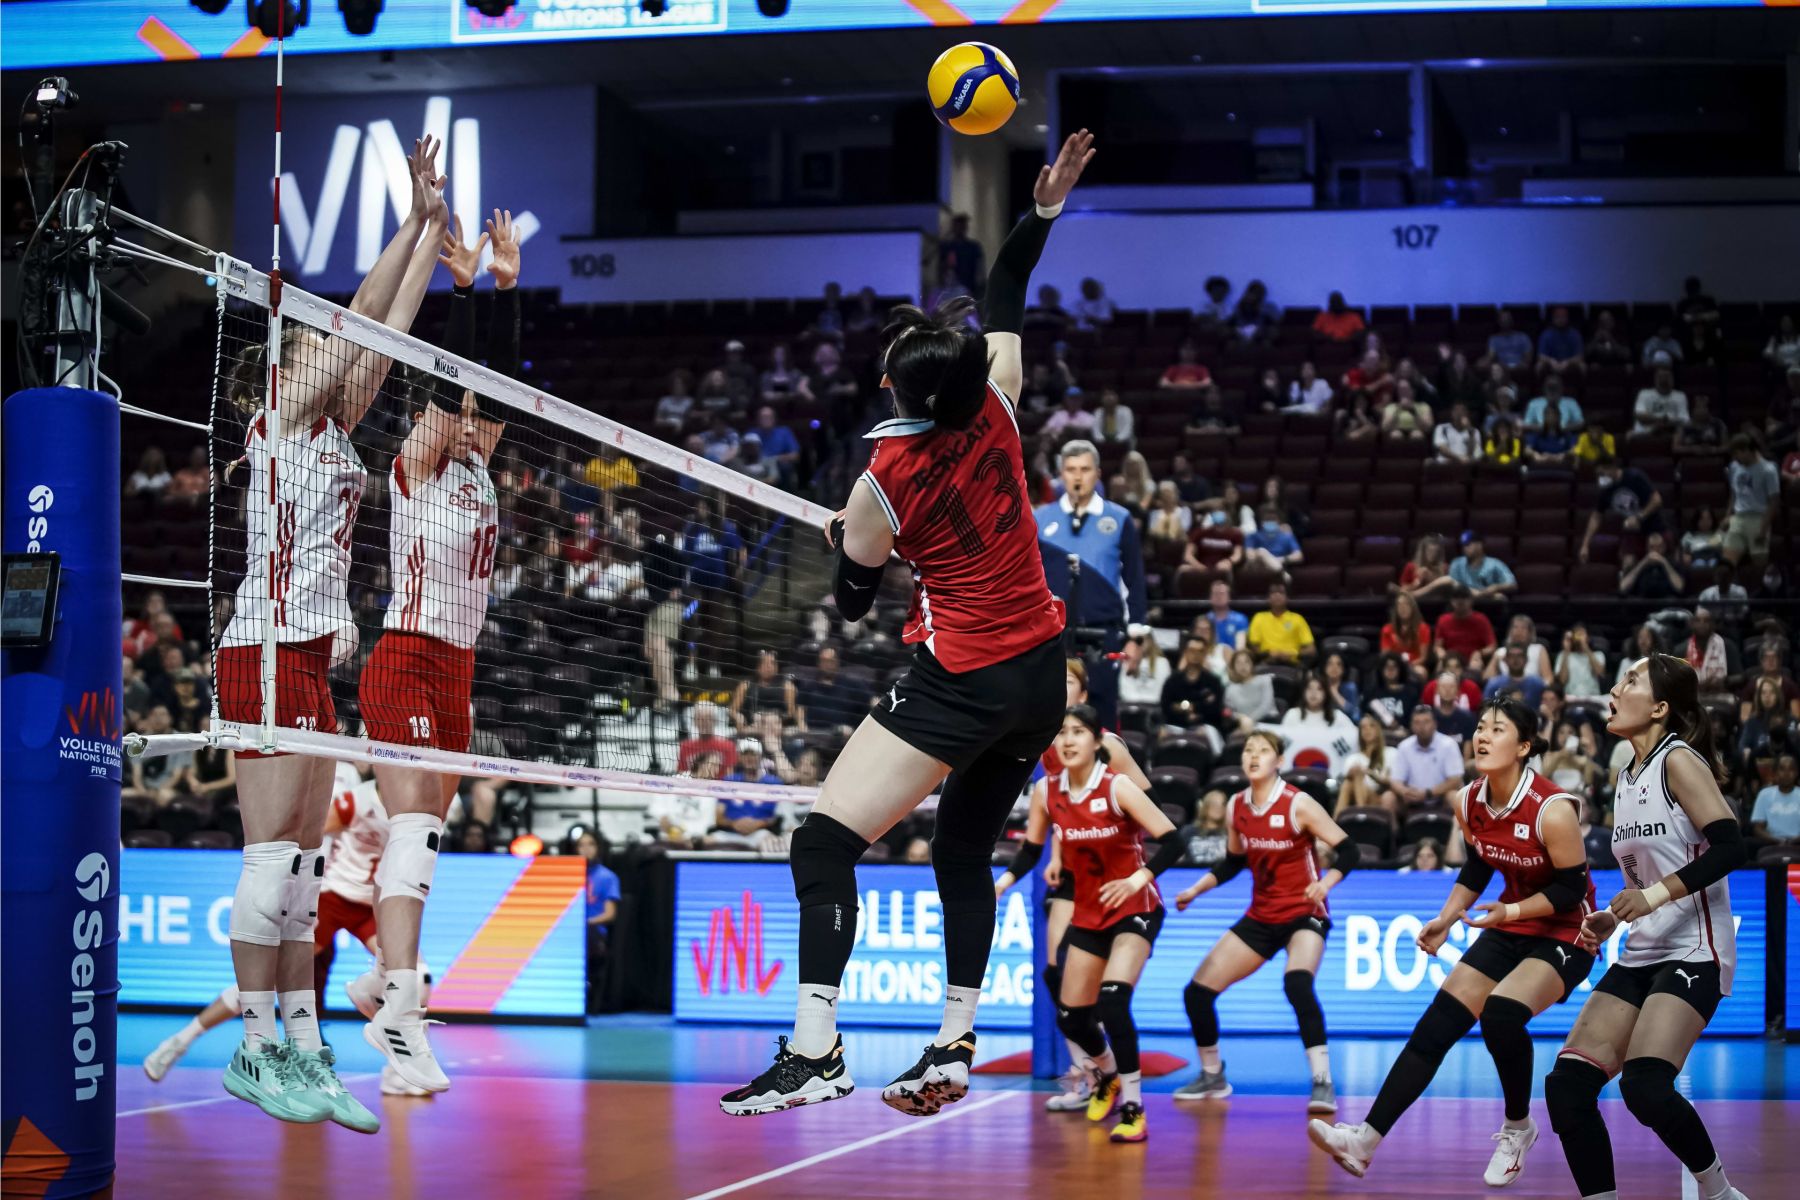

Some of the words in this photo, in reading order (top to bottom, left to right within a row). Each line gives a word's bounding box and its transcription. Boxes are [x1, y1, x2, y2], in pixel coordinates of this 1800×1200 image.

[1392, 224, 1440, 249] 107
[568, 254, 616, 278] 108
[925, 448, 1023, 558] 13
[468, 524, 498, 580] 18
[408, 715, 430, 739] 18
[60, 749, 100, 763] NATIONS
[1066, 825, 1119, 840] Shinhan
[1249, 837, 1294, 849] Shinhan
[1613, 820, 1667, 843] Shinhan
[1486, 844, 1544, 867] Shinhan
[119, 895, 191, 944] HE
[71, 910, 104, 1101] Senoh
